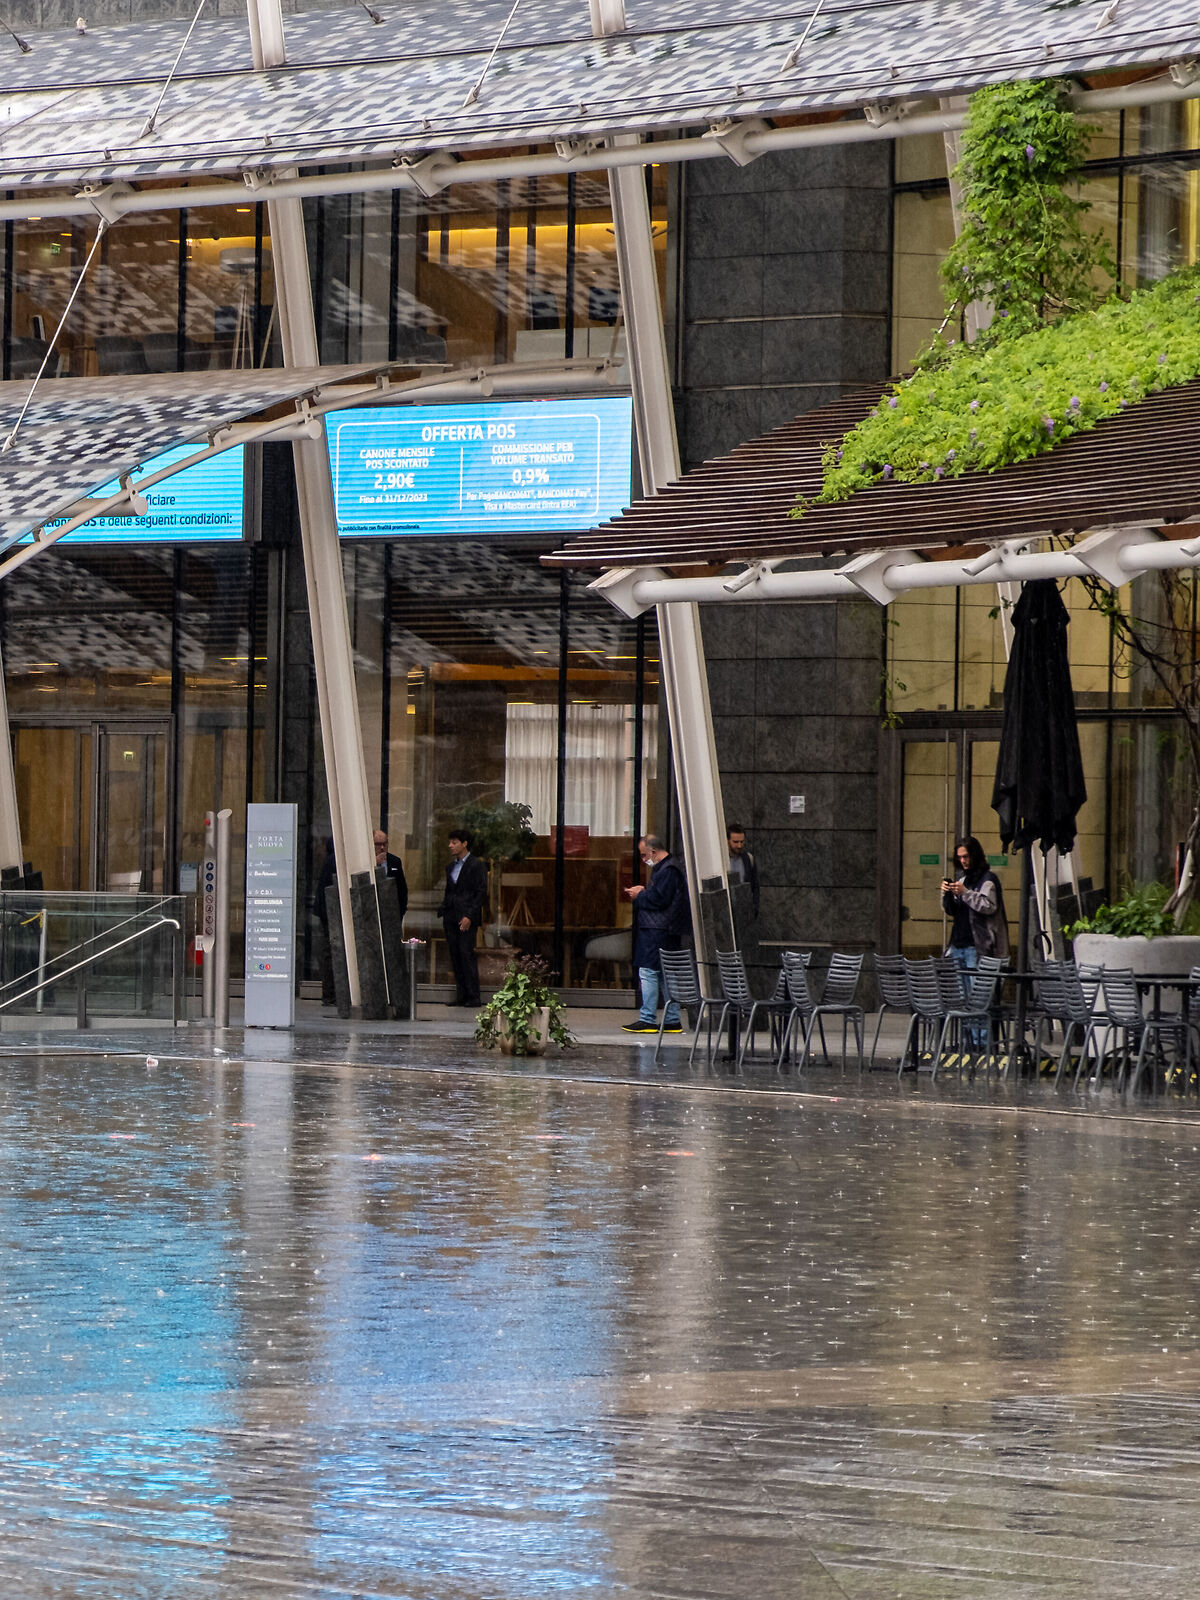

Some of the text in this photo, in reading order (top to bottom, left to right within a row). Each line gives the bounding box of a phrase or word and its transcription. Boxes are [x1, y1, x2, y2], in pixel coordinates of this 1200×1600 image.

[421, 423, 516, 442] OFFERTA POS
[360, 447, 436, 459] CANONE MENSILE
[492, 442, 574, 454] COMMISSIONE PER
[365, 458, 429, 470] POS SCONTATO
[490, 453, 575, 465] VOLUME TRANSATO
[374, 472, 415, 491] 2,90€
[512, 468, 550, 487] 0,9%
[384, 493, 428, 503] 31/12/2023
[99, 517, 106, 527] e
[108, 515, 133, 526] delle
[135, 514, 177, 528] seguenti
[180, 512, 233, 525] condizioni:
